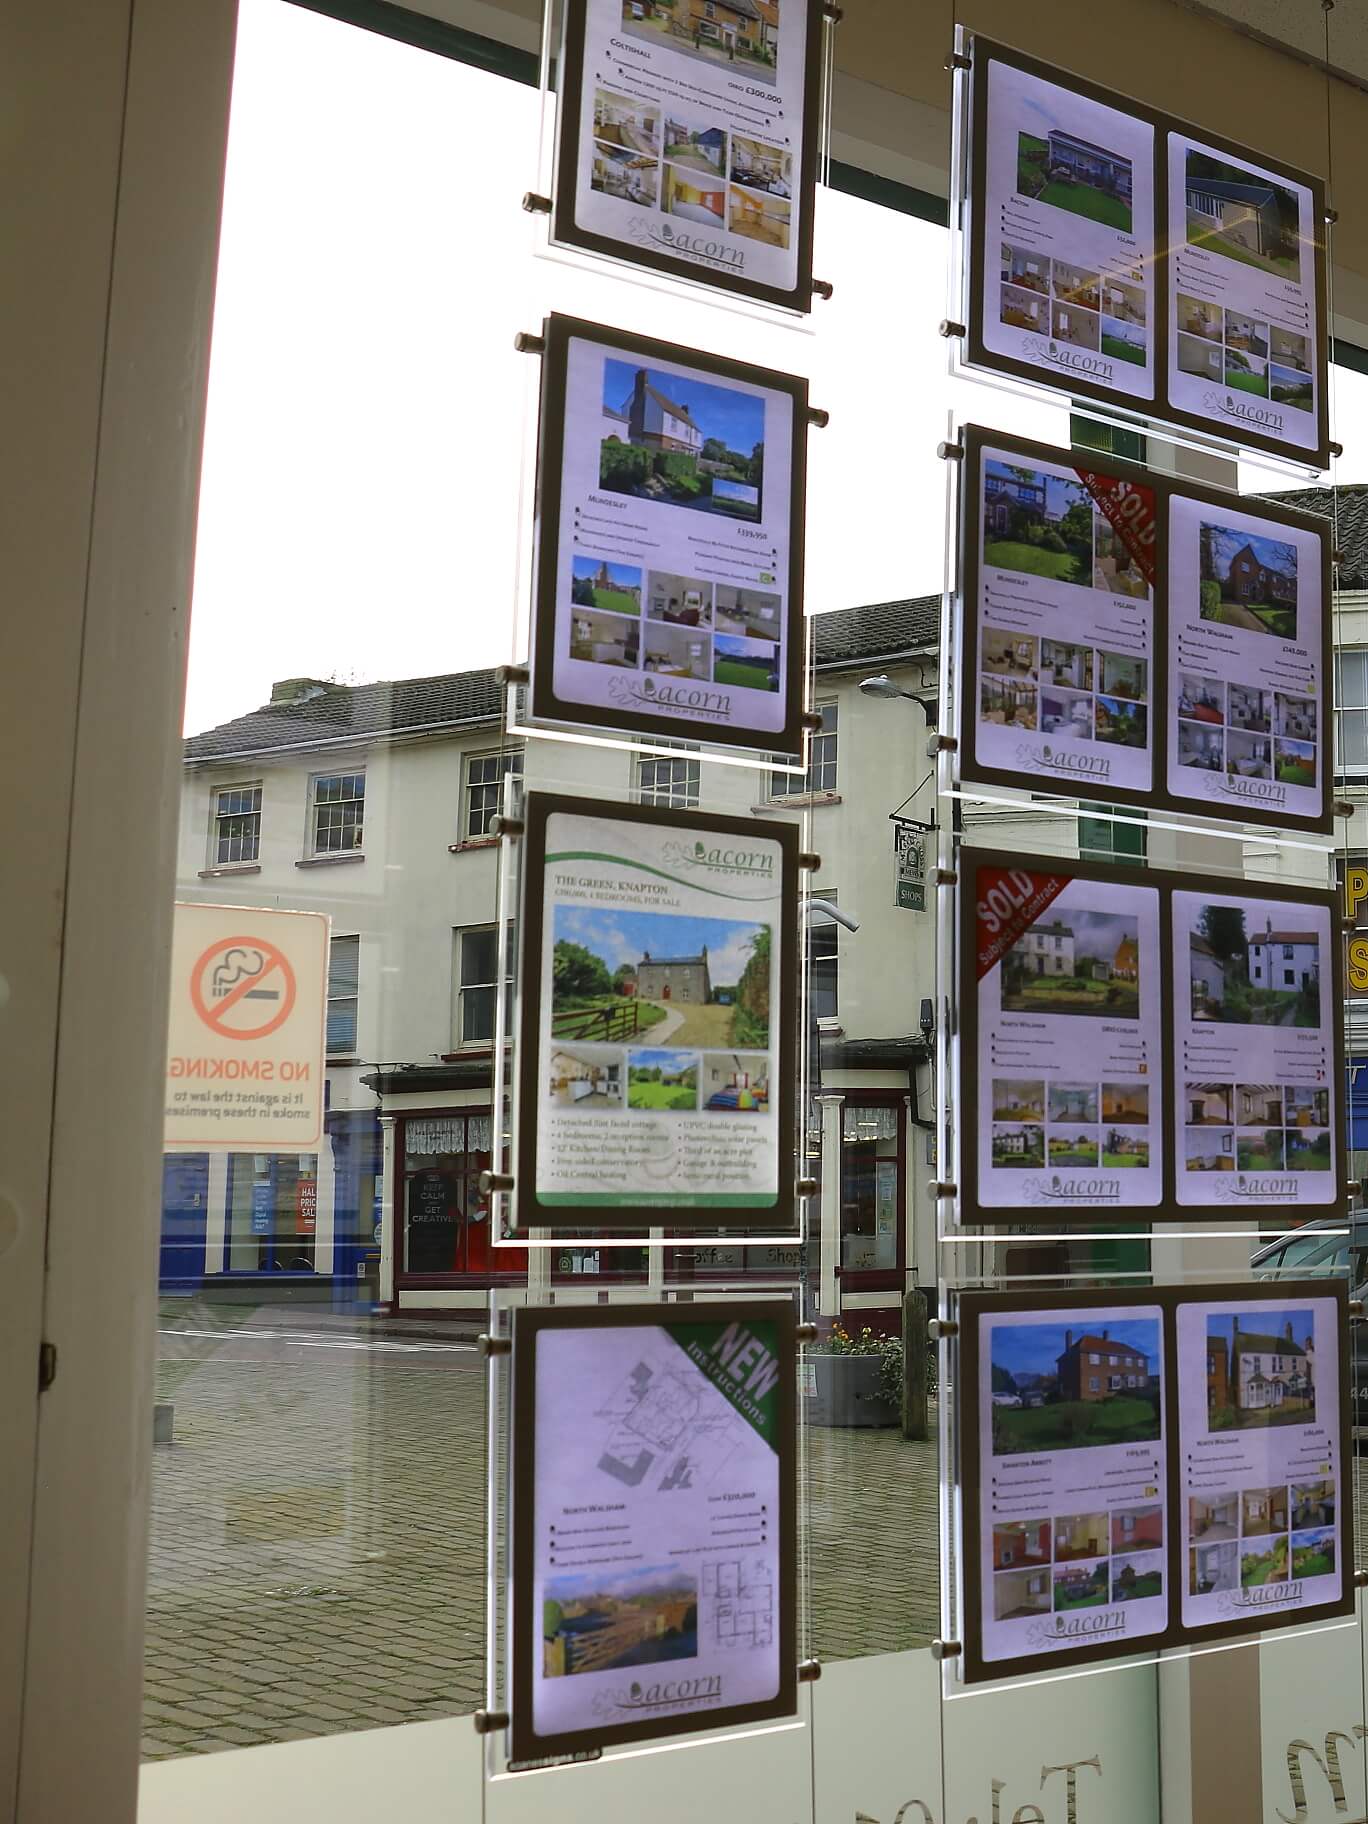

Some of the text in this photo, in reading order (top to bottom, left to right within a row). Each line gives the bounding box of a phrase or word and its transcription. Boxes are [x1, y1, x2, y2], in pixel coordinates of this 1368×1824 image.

[676, 235, 747, 267] acorn
[1058, 347, 1114, 378] acorn
[1236, 402, 1286, 428] acorn
[1111, 482, 1156, 544] SOLD
[658, 686, 733, 712] acorn
[1054, 753, 1111, 773] acorn
[1237, 778, 1287, 799] acorn
[708, 848, 774, 870] acorn
[555, 875, 577, 886] THE
[618, 881, 668, 895] KNAPTON
[901, 889, 922, 903] SHOPS
[977, 869, 1034, 933] SOLD
[302, 1186, 316, 1197] HAL
[420, 1192, 445, 1200] CALM
[1064, 1179, 1121, 1195] acorn
[1249, 1178, 1298, 1194] acorn
[300, 1198, 316, 1207] PRIC
[301, 1208, 316, 1217] SAL
[425, 1206, 440, 1214] GET
[711, 1321, 779, 1400] NEW
[1253, 1581, 1304, 1605] acorn
[1067, 1608, 1126, 1634] acorn
[646, 1675, 722, 1701] acorn
